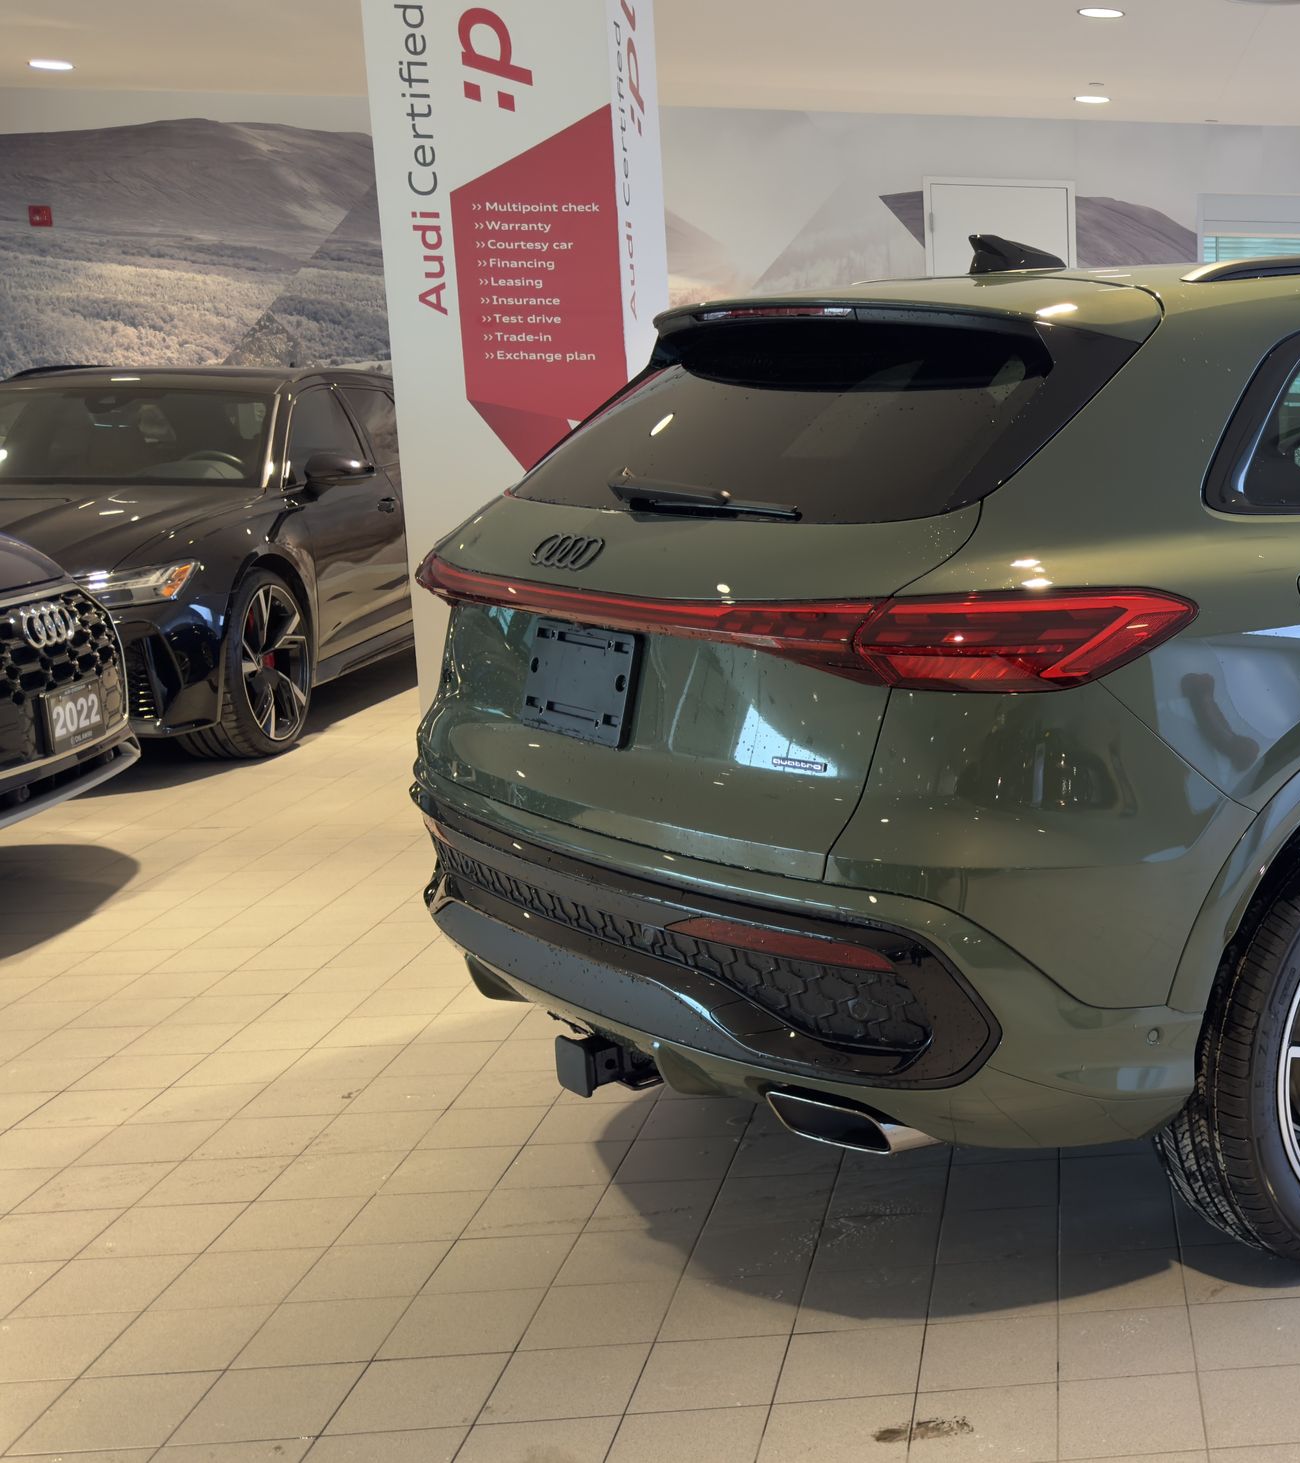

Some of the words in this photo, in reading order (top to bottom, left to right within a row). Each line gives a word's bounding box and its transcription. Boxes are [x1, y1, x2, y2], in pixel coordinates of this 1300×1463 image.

[394, 3, 438, 196] Certified
[613, 20, 631, 207] Certified
[485, 202, 558, 214] Multipoint
[561, 203, 600, 212] check
[485, 221, 552, 233] Warranty
[487, 240, 549, 252] Courtesy
[552, 242, 574, 250] car
[411, 210, 448, 316] Audi
[489, 258, 555, 271] Financing
[625, 220, 638, 321] Audi
[490, 276, 543, 289] Leasing
[492, 295, 561, 306] Insurance
[493, 314, 524, 324] Test
[527, 314, 562, 324] drive
[495, 332, 552, 342] Trade-in
[496, 350, 562, 363] Exchange
[566, 351, 596, 363] plan
[53, 693, 101, 738] 2022
[772, 758, 822, 771] quattro
